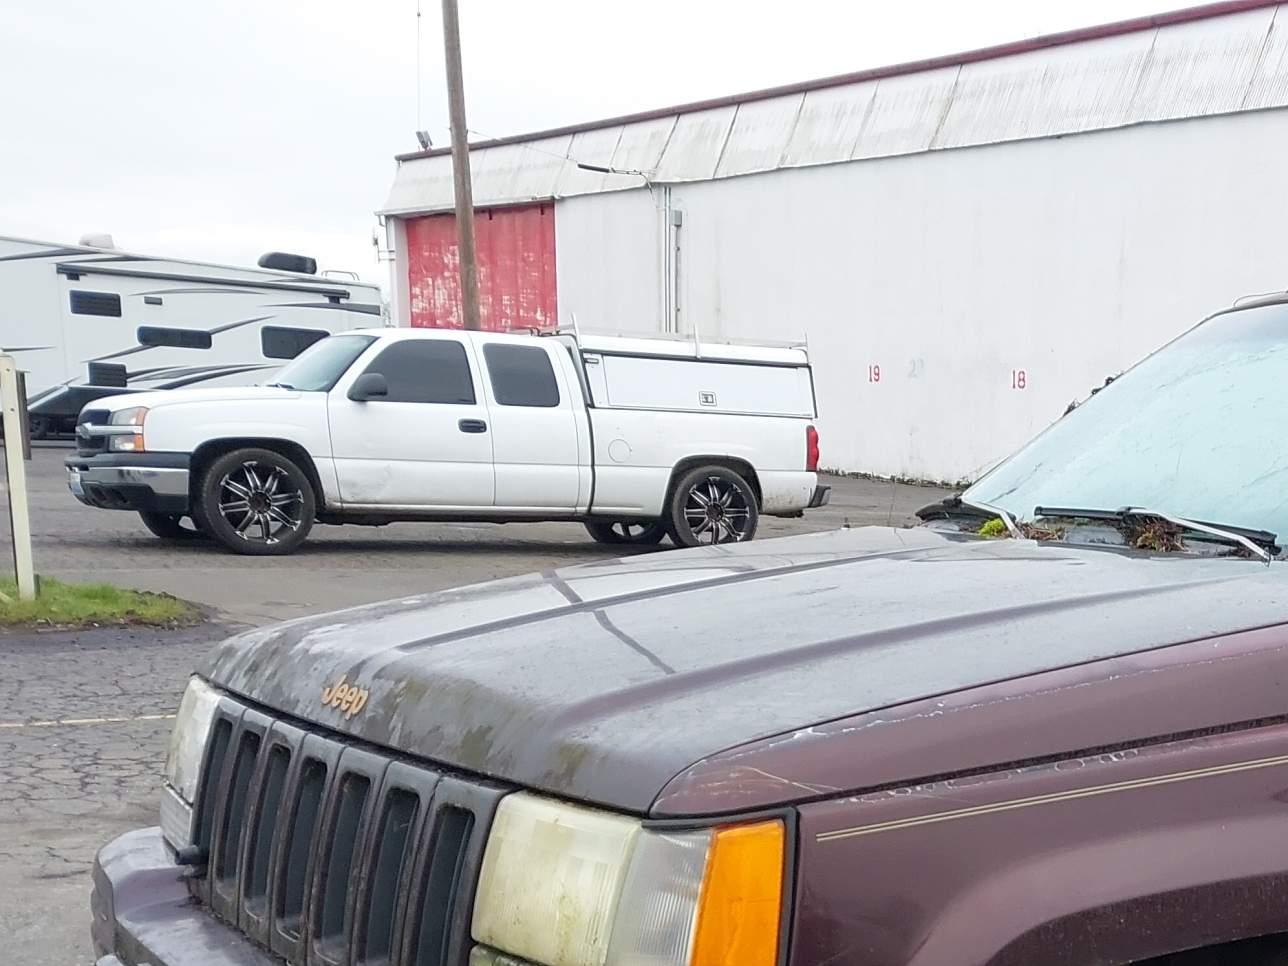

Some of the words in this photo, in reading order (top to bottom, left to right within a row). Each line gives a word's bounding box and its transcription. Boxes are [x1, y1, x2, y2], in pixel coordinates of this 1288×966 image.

[868, 365, 881, 383] 19
[1012, 370, 1026, 390] 18
[321, 674, 369, 720] Jeep
